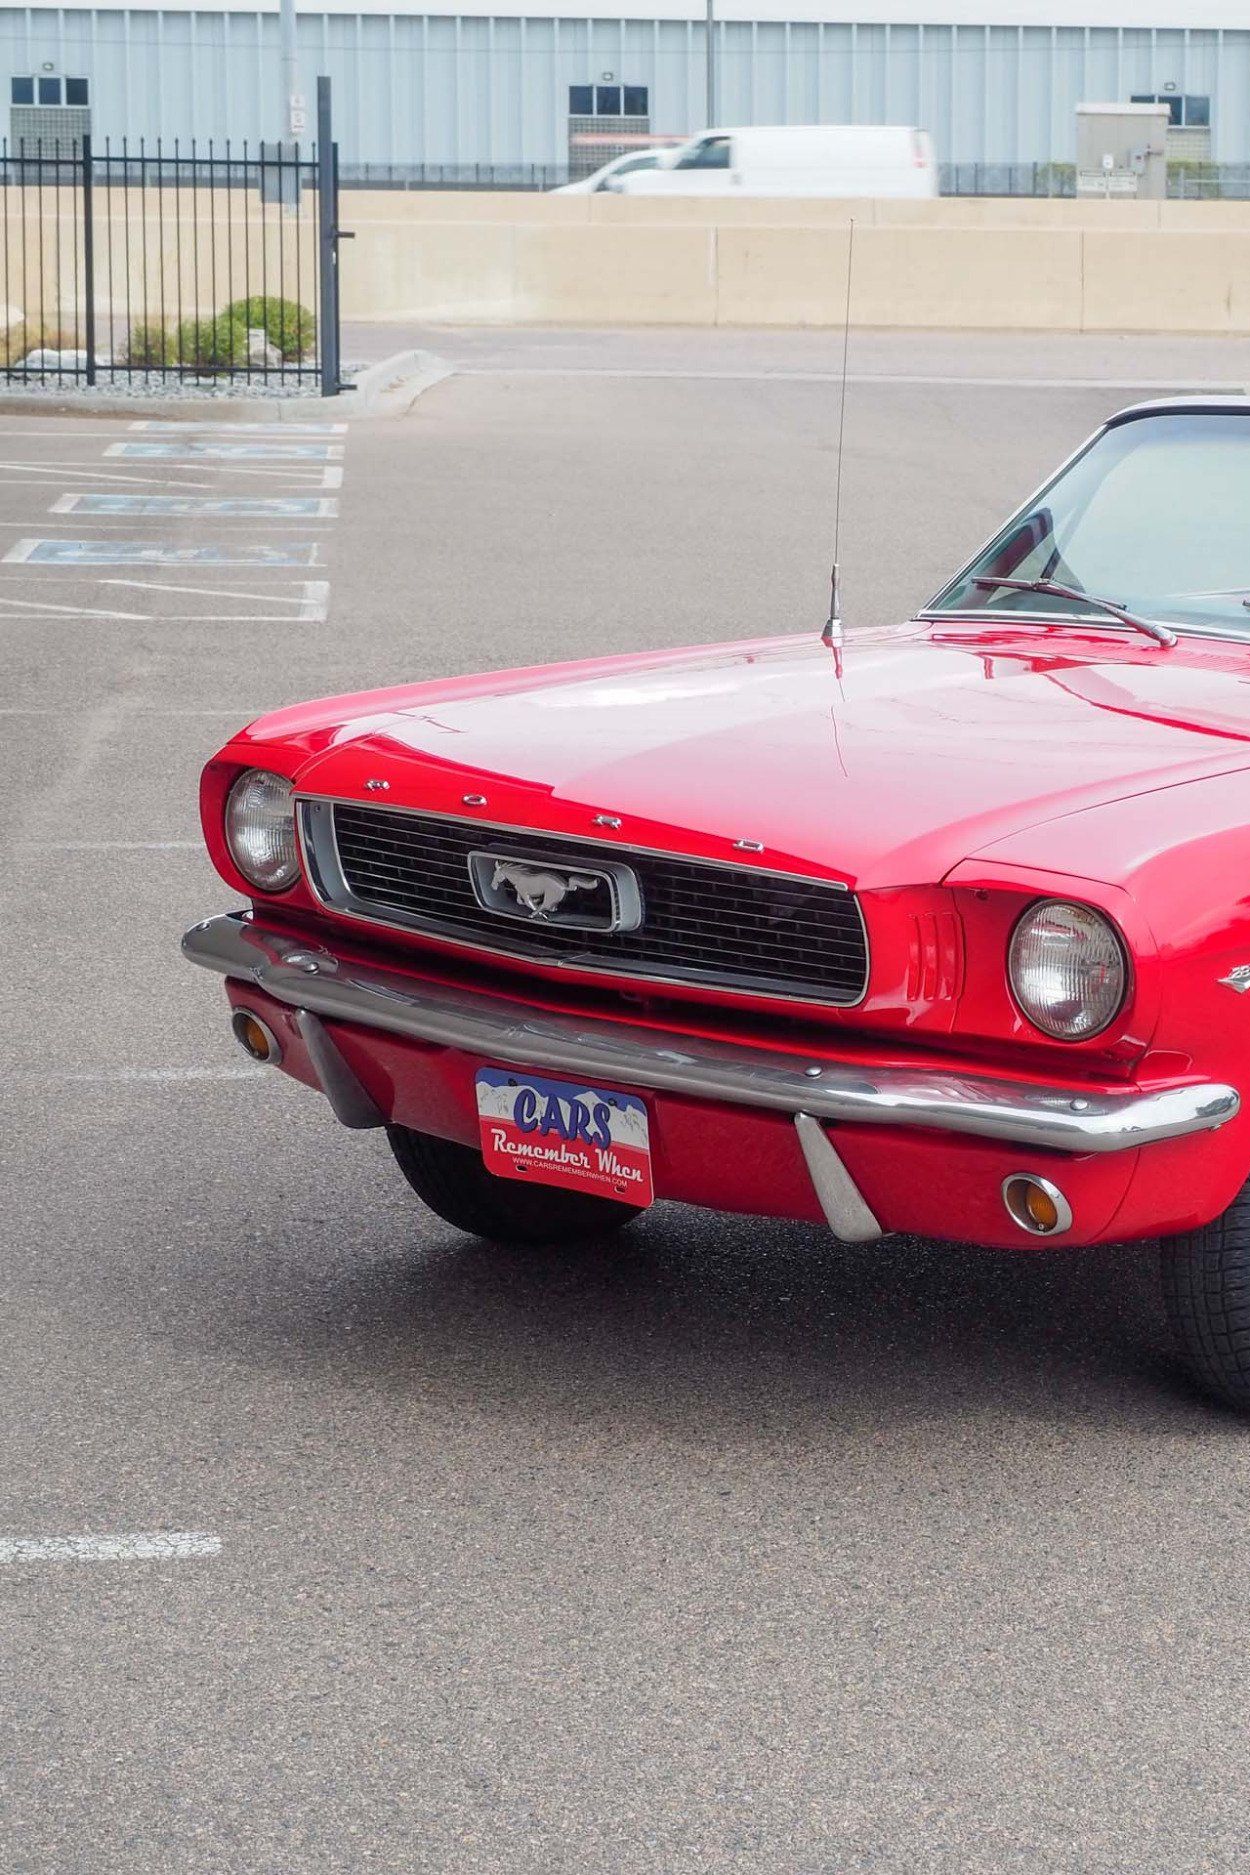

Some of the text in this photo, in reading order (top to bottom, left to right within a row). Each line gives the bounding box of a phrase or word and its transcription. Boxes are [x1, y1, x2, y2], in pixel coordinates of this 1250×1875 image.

[514, 1089, 611, 1149] CARS
[491, 1128, 643, 1182] Remember When
[512, 1156, 628, 1188] WWW.CARSREMEMBERWHEN.COM
